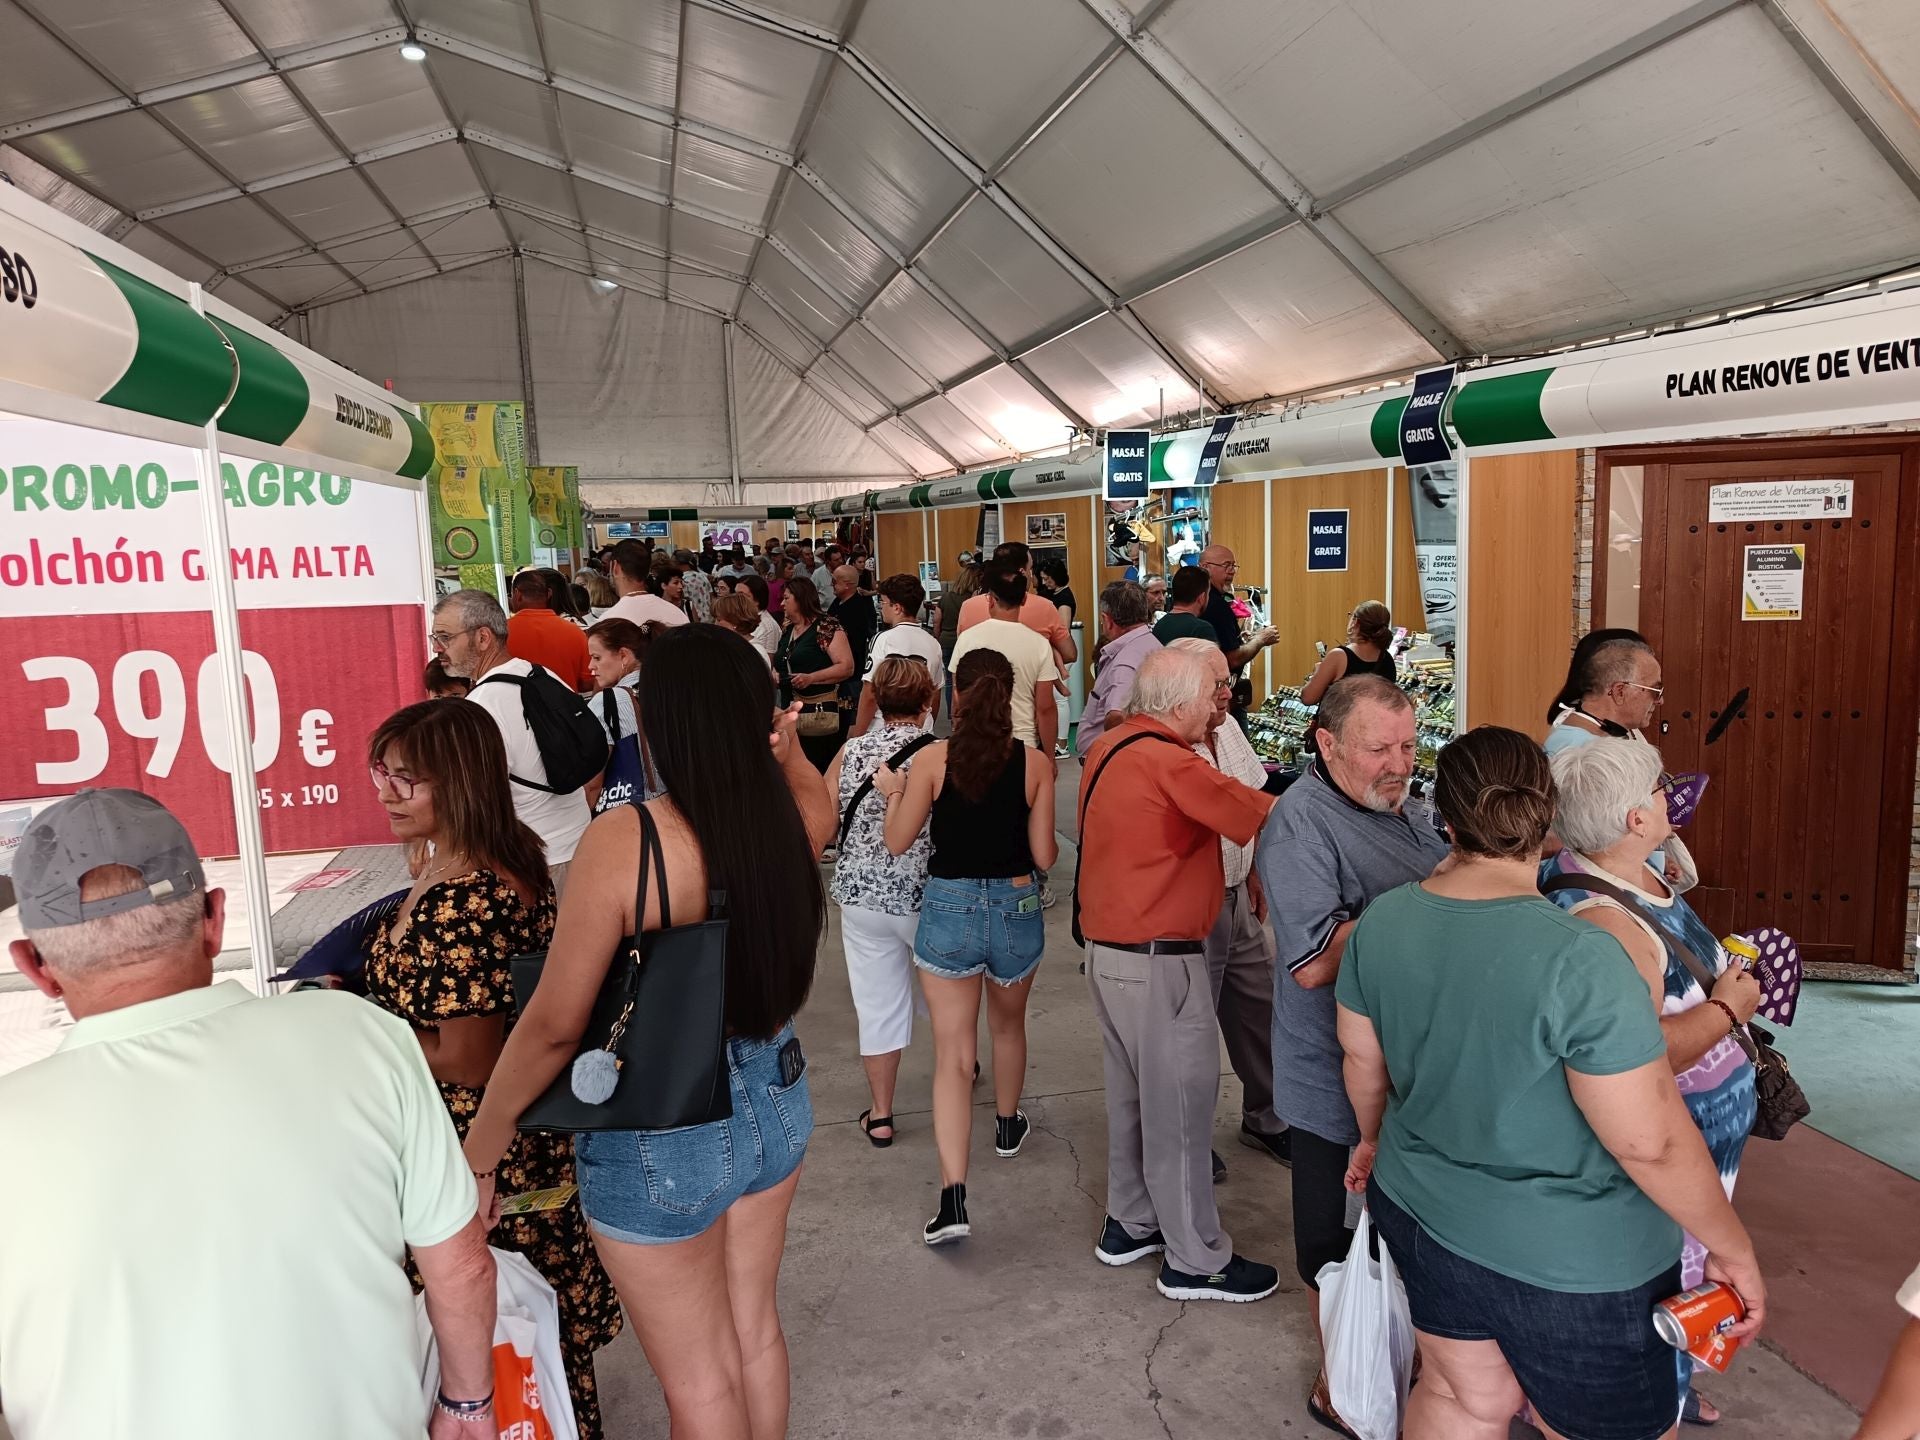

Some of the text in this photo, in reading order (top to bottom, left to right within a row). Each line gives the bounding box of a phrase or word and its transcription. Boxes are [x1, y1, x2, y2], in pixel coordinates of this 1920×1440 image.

[0, 245, 38, 309] SO
[1666, 369, 1716, 399] PLAN
[1722, 355, 1810, 393] RENOVE
[1816, 348, 1850, 381] DE
[1410, 391, 1444, 409] MASAJE
[1209, 431, 1228, 444] MASAJE
[1405, 427, 1435, 443] GRATIS
[1112, 447, 1145, 458] MASAJE
[1225, 437, 1270, 458] DURAYSANCH
[1201, 457, 1218, 468] GRATIS
[1113, 471, 1143, 482] GRATIS
[0, 462, 199, 511] ROMO-
[1712, 487, 1731, 498] Plan
[1735, 486, 1766, 497] Renove
[1770, 486, 1782, 496] de
[1786, 484, 1831, 496] Ventanas
[704, 528, 750, 546] 360
[1312, 525, 1343, 535] MASAJE
[1314, 546, 1341, 556] GRATIS
[182, 547, 279, 581] GMA
[292, 545, 375, 579] ALTA
[21, 650, 337, 784] 390 €
[280, 792, 295, 808] x
[301, 784, 339, 806] 190
[608, 781, 632, 799] chc
[1758, 959, 1777, 988] AVATEL
